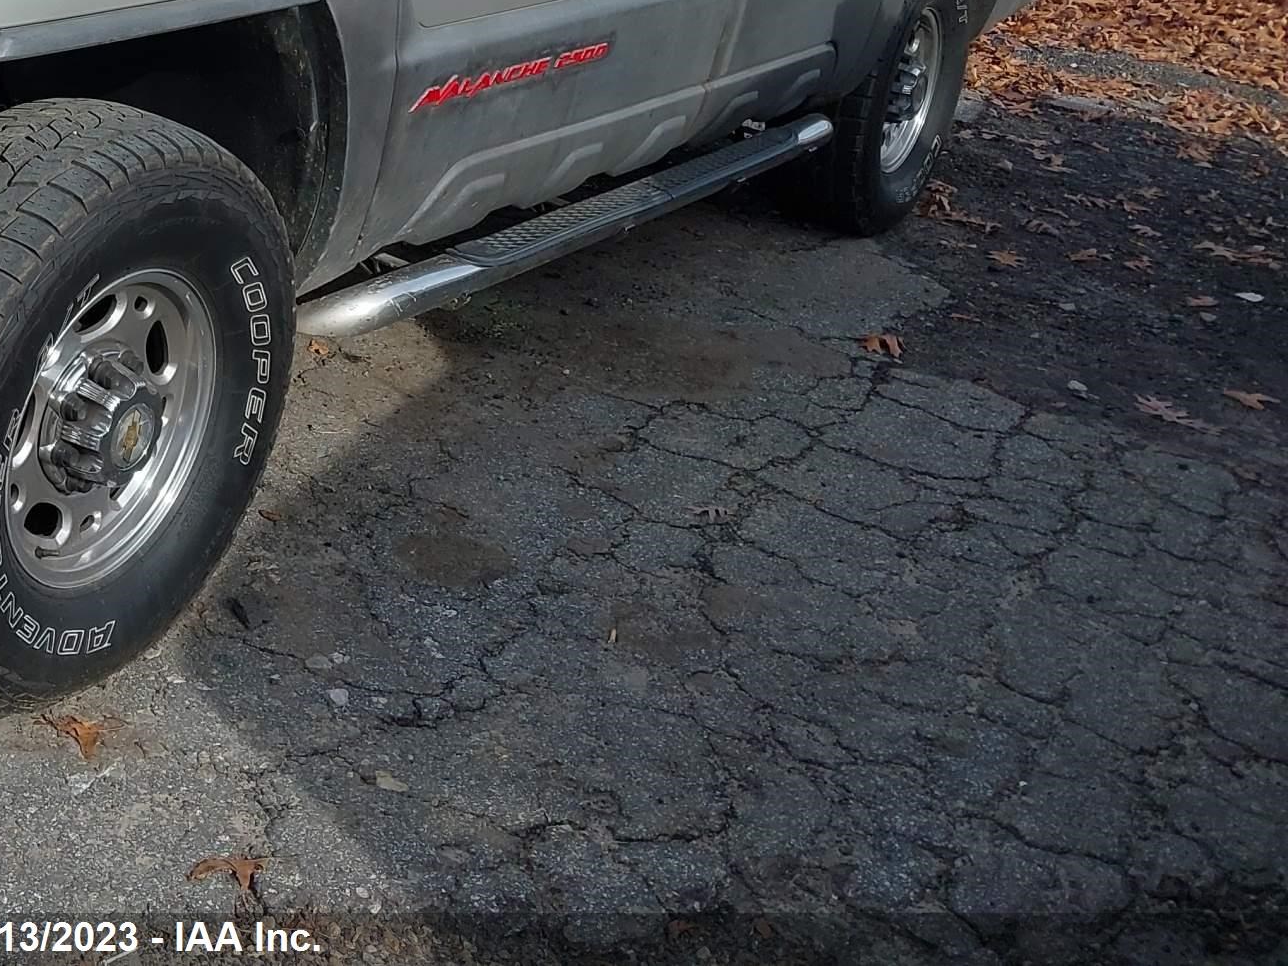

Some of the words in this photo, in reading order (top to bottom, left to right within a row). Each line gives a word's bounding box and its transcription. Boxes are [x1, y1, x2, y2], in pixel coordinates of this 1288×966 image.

[408, 56, 553, 114] AVALANCHE
[554, 42, 609, 69] 2500
[231, 256, 271, 468] COOPER
